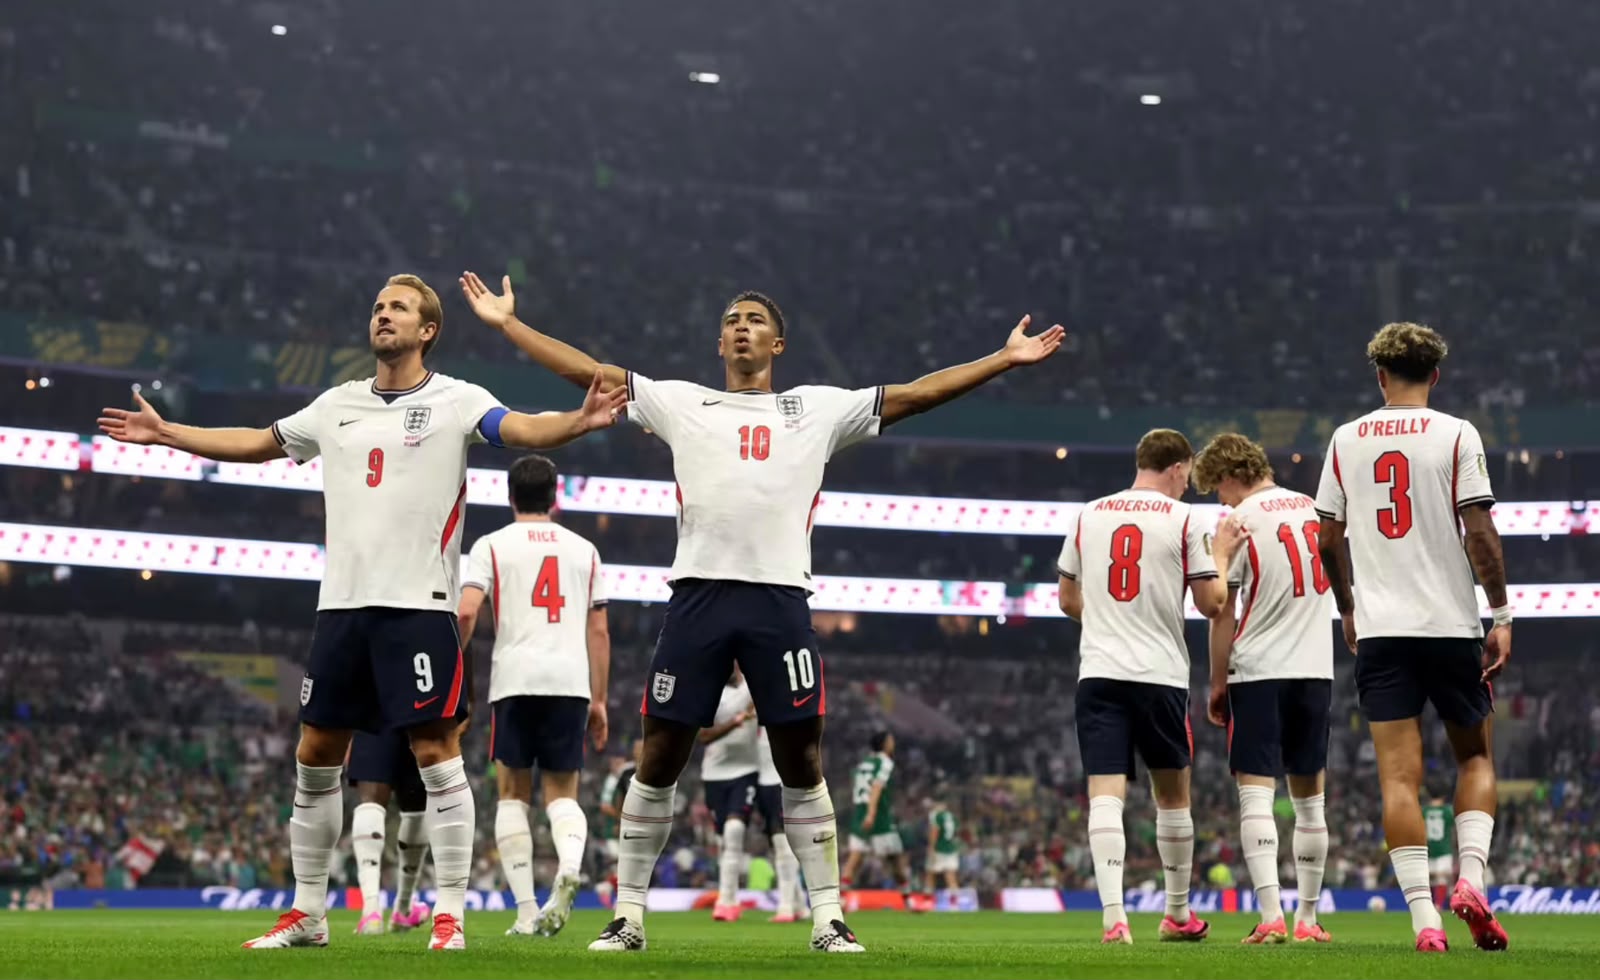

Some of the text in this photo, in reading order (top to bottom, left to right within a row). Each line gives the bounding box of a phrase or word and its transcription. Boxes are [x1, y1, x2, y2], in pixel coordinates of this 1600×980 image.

[738, 425, 771, 461] 10
[1357, 417, 1431, 438] O'REILLY
[366, 447, 384, 488] 9
[1094, 496, 1173, 514] ANDERSON
[1259, 496, 1314, 513] GORDON
[1373, 450, 1413, 540] 3
[527, 530, 558, 543] RICE
[1107, 523, 1144, 603] 8
[531, 555, 566, 624] 4
[413, 652, 434, 693] 9
[783, 647, 815, 692] 10
